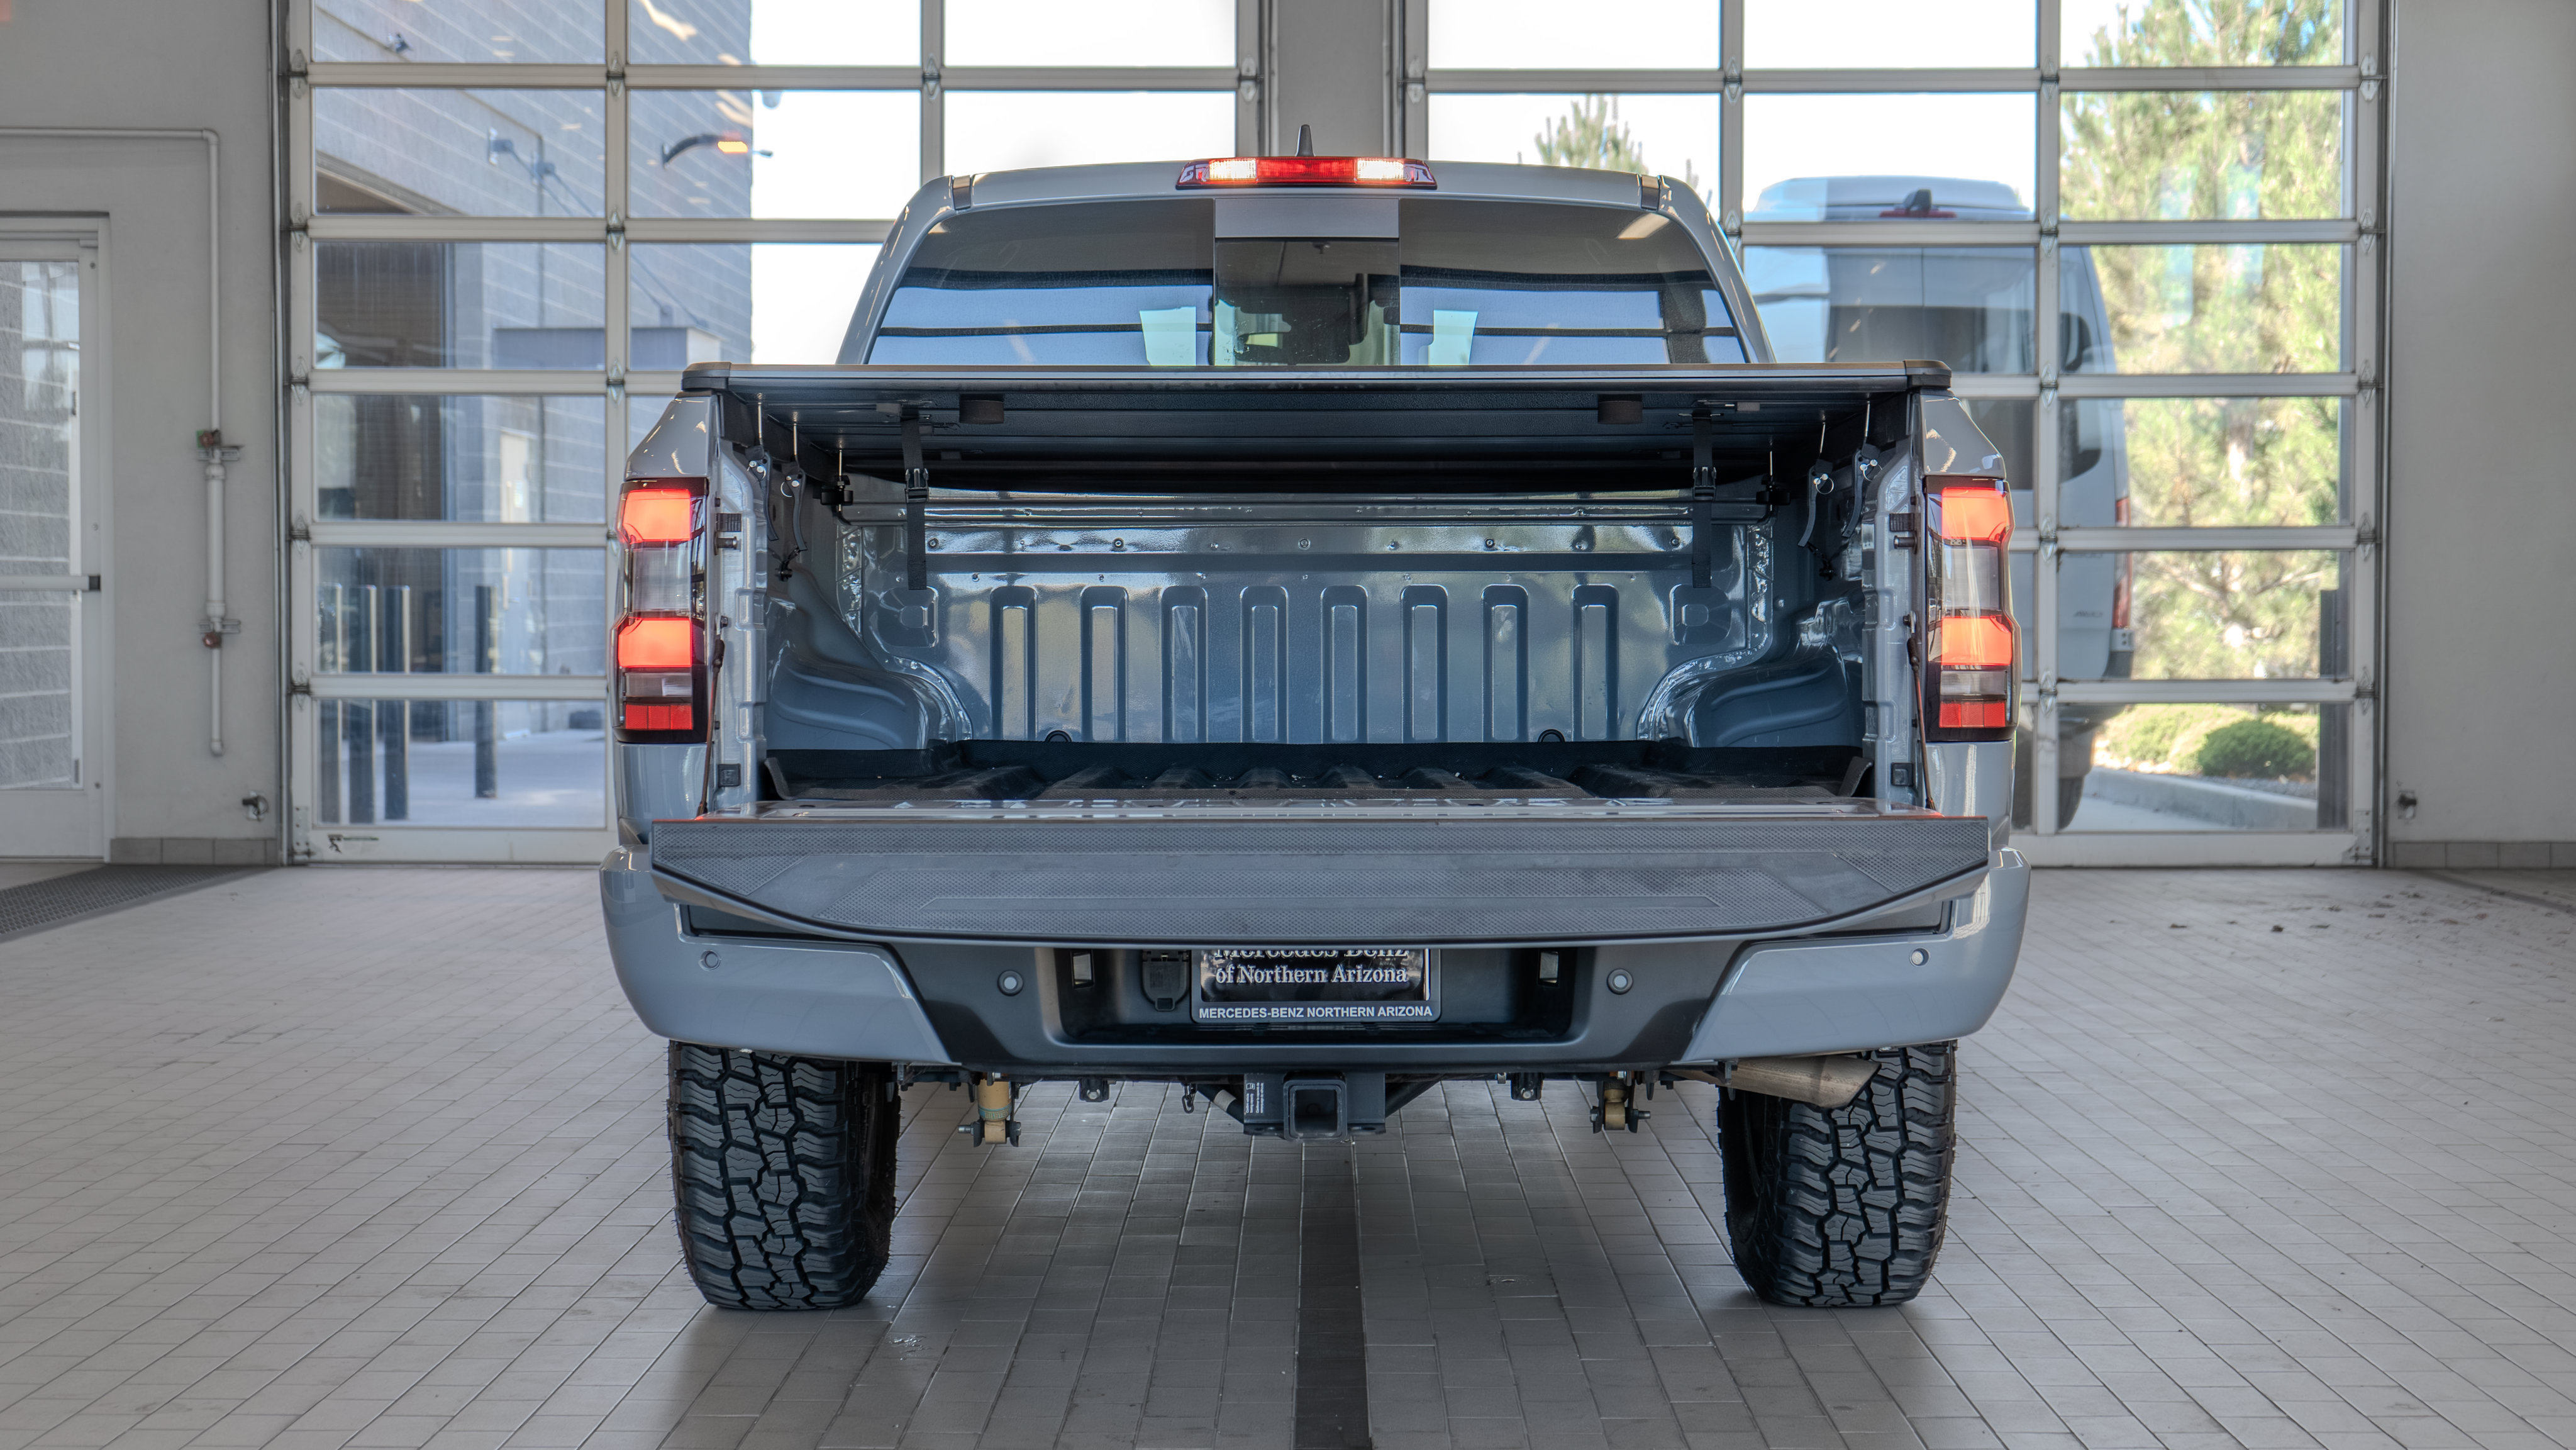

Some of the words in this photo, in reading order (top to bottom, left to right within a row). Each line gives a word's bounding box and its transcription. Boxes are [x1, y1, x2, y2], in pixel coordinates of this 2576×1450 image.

[1215, 965, 1234, 984] of
[1236, 964, 1327, 984] Northern
[1331, 964, 1407, 984] Arizona
[1199, 1008, 1304, 1019] MERCEDES-BENZ
[1306, 1007, 1376, 1018] NORTHERN
[1377, 1006, 1433, 1018] ARIZONA
